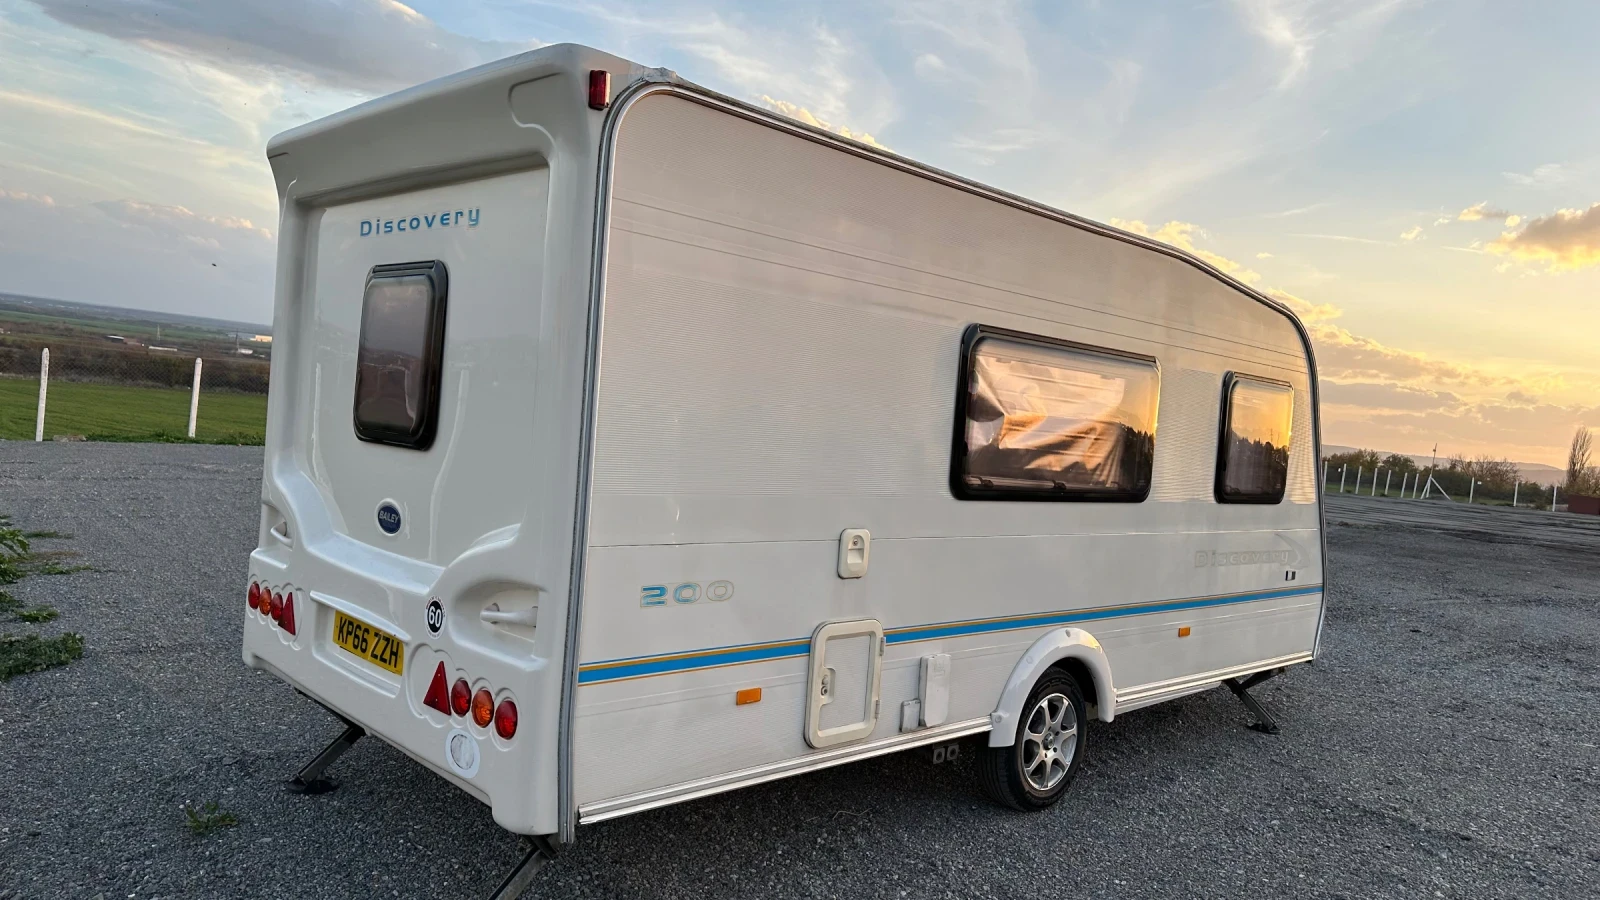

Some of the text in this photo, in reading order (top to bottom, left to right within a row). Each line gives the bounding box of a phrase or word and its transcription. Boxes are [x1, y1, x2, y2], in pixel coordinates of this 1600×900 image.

[360, 208, 480, 237] Discovery
[378, 510, 400, 523] BAILEY
[1195, 550, 1290, 567] Discovery
[640, 580, 734, 607] 200
[428, 605, 442, 628] 60
[338, 616, 400, 668] KP66 ZZH
